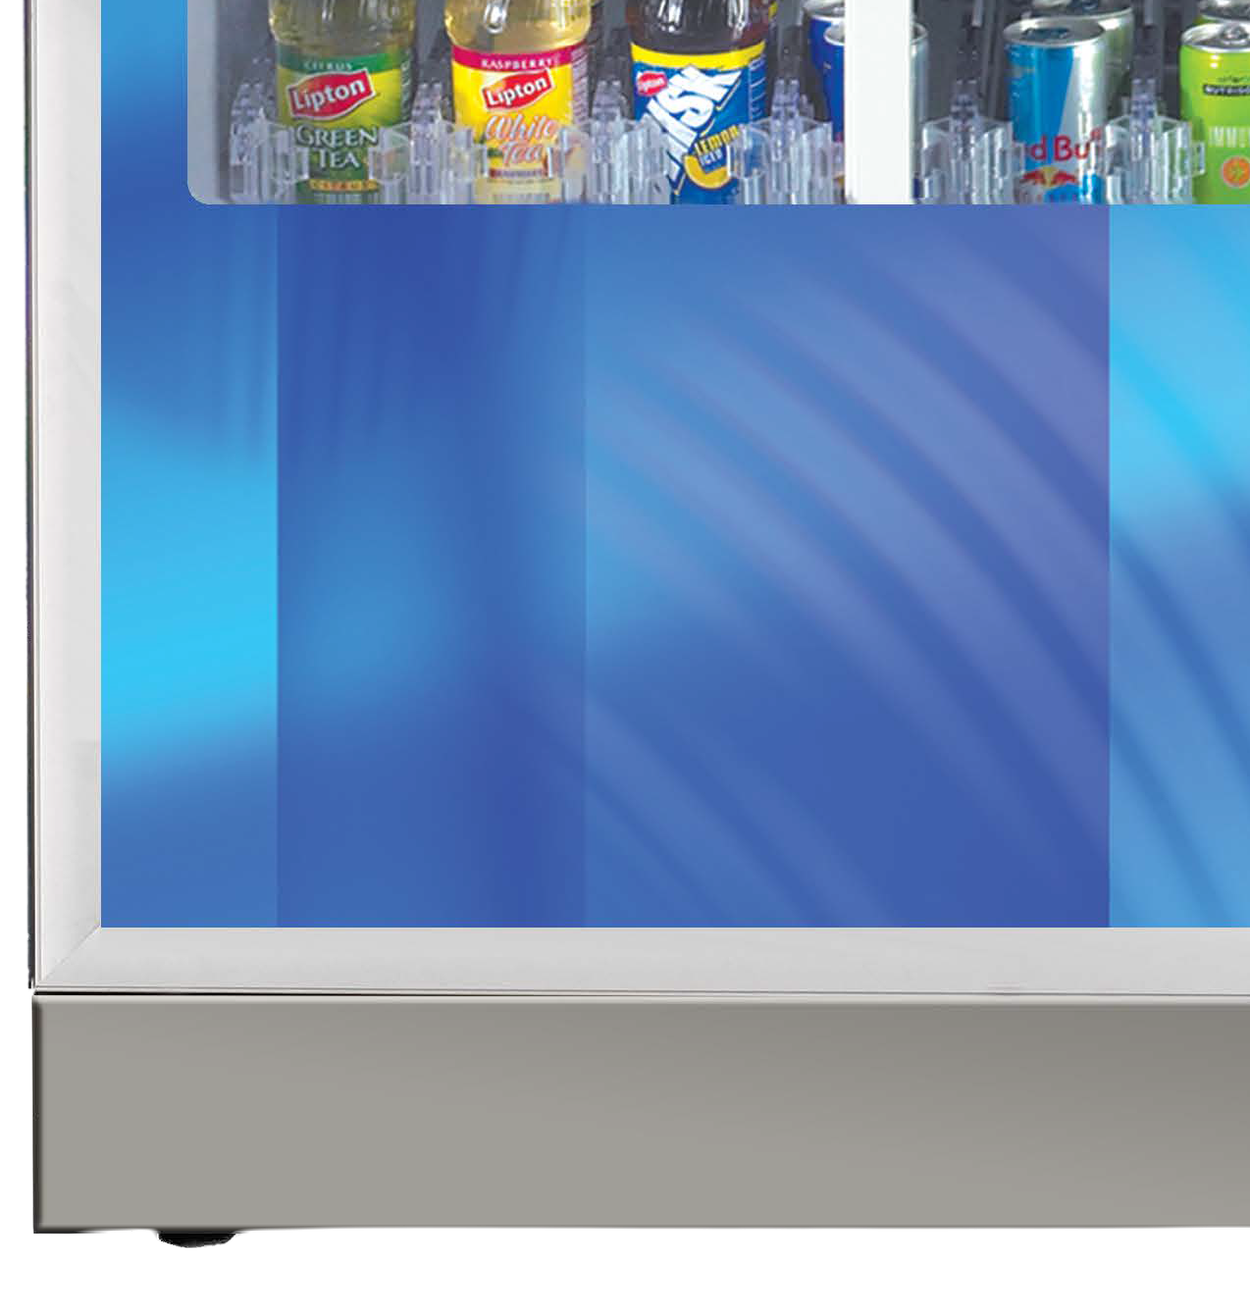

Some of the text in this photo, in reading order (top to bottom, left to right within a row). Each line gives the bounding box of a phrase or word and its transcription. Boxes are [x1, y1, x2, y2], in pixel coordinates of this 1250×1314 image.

[480, 57, 556, 70] RASPBERRY
[291, 77, 367, 110] Lipton
[485, 75, 548, 109] Lipton
[296, 124, 380, 148] GREEN
[484, 113, 558, 142] White
[695, 125, 739, 156] LEMON
[313, 146, 362, 170] TEA
[502, 140, 543, 166] Tea
